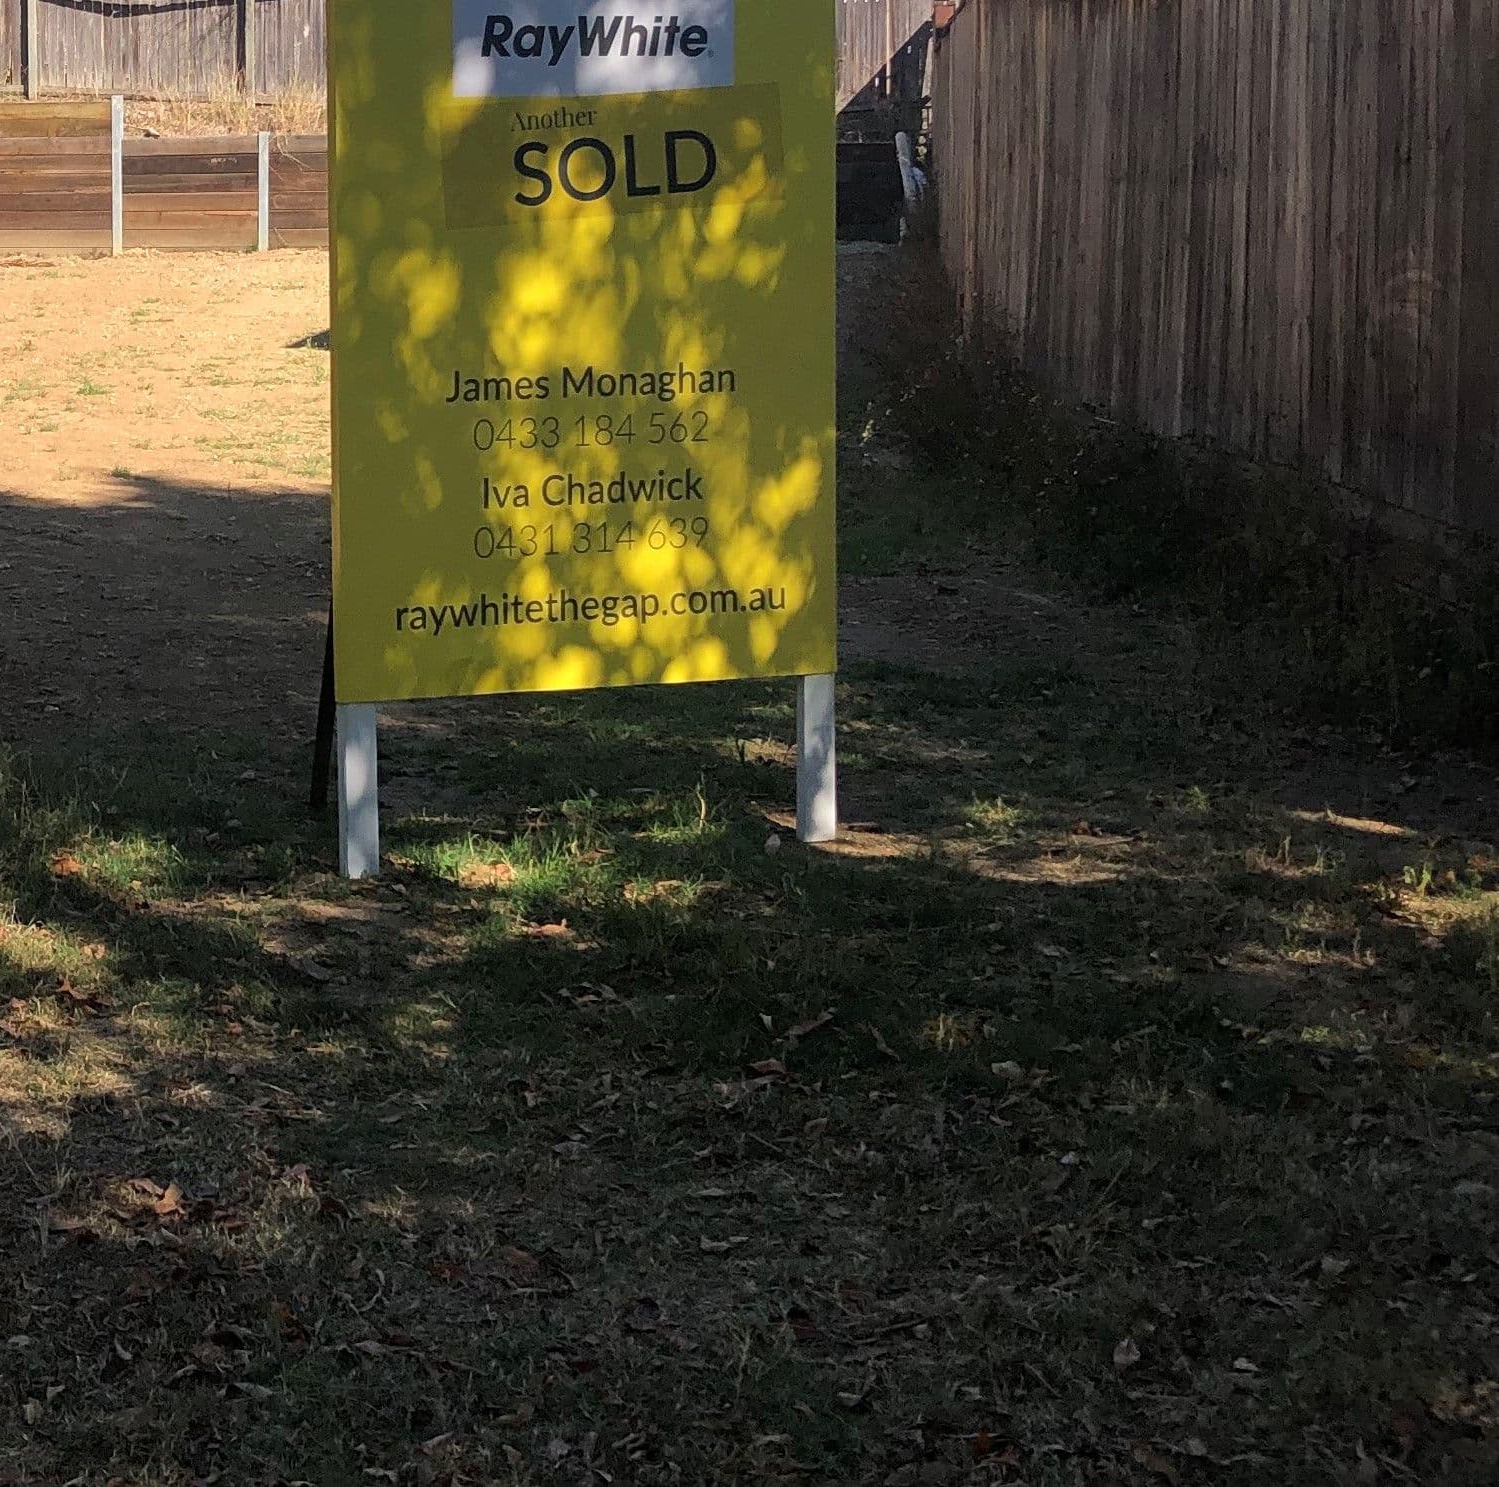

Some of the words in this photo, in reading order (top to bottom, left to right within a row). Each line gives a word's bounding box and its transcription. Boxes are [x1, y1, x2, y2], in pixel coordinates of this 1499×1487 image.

[511, 107, 598, 132] Another
[513, 129, 717, 206] SOLD
[446, 370, 550, 403] James
[562, 363, 737, 401] Monaghan
[473, 417, 560, 451] 0433
[574, 413, 637, 447] 184
[648, 411, 710, 444] 562
[483, 477, 530, 509] Iva
[541, 468, 703, 506] Chadwick
[473, 525, 560, 559] 0431
[572, 521, 635, 554] 314
[647, 516, 709, 550] 639
[395, 585, 787, 636] raywhitethegap.com.au
